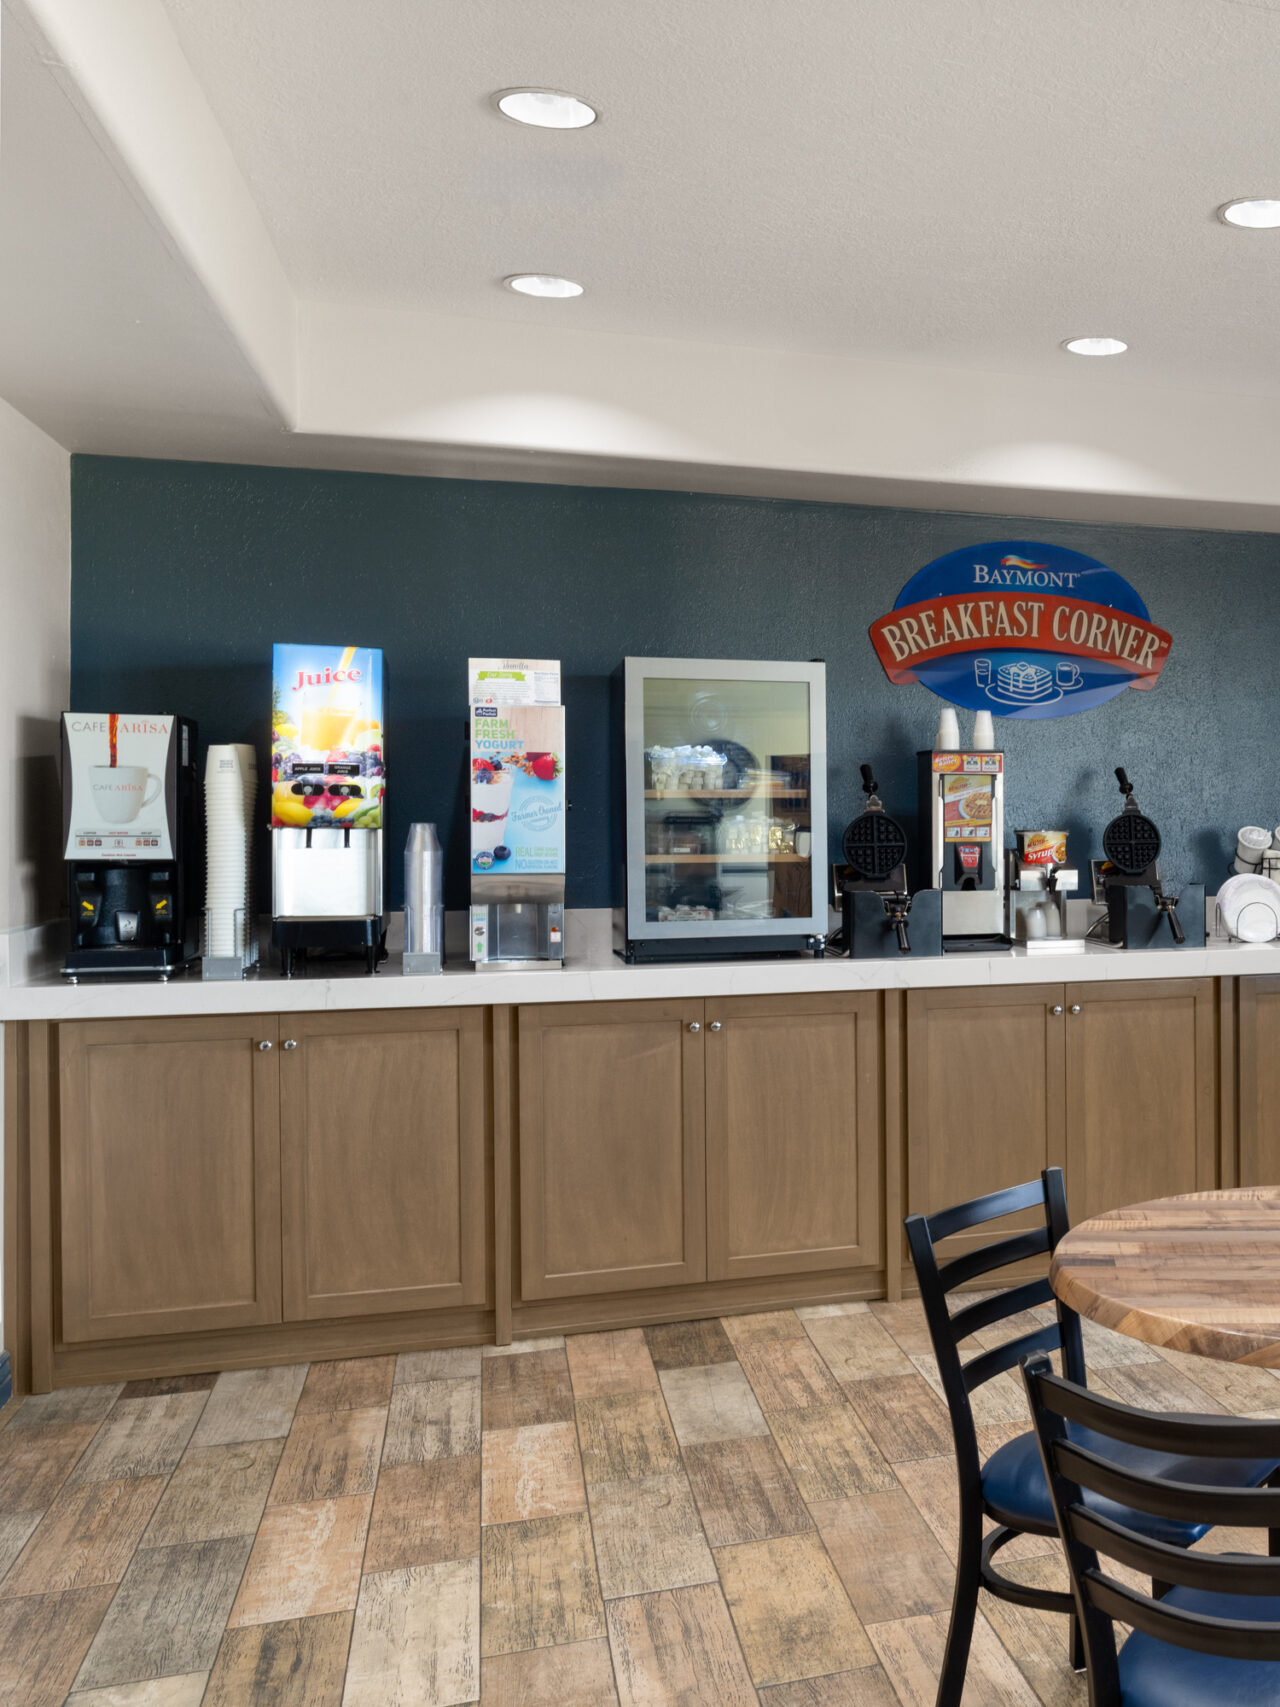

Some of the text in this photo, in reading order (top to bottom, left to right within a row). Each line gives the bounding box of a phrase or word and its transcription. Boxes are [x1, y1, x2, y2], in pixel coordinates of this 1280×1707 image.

[973, 564, 1077, 588] BAYMONT
[881, 600, 1161, 670] BREAKFAST CORNER
[292, 667, 362, 691] Juice
[71, 721, 107, 733] CAFE
[475, 718, 509, 728] FARM
[475, 729, 515, 739] FRESH
[475, 740, 524, 750] YOGURT
[515, 847, 533, 857] REAL
[1028, 848, 1054, 862] Syrup
